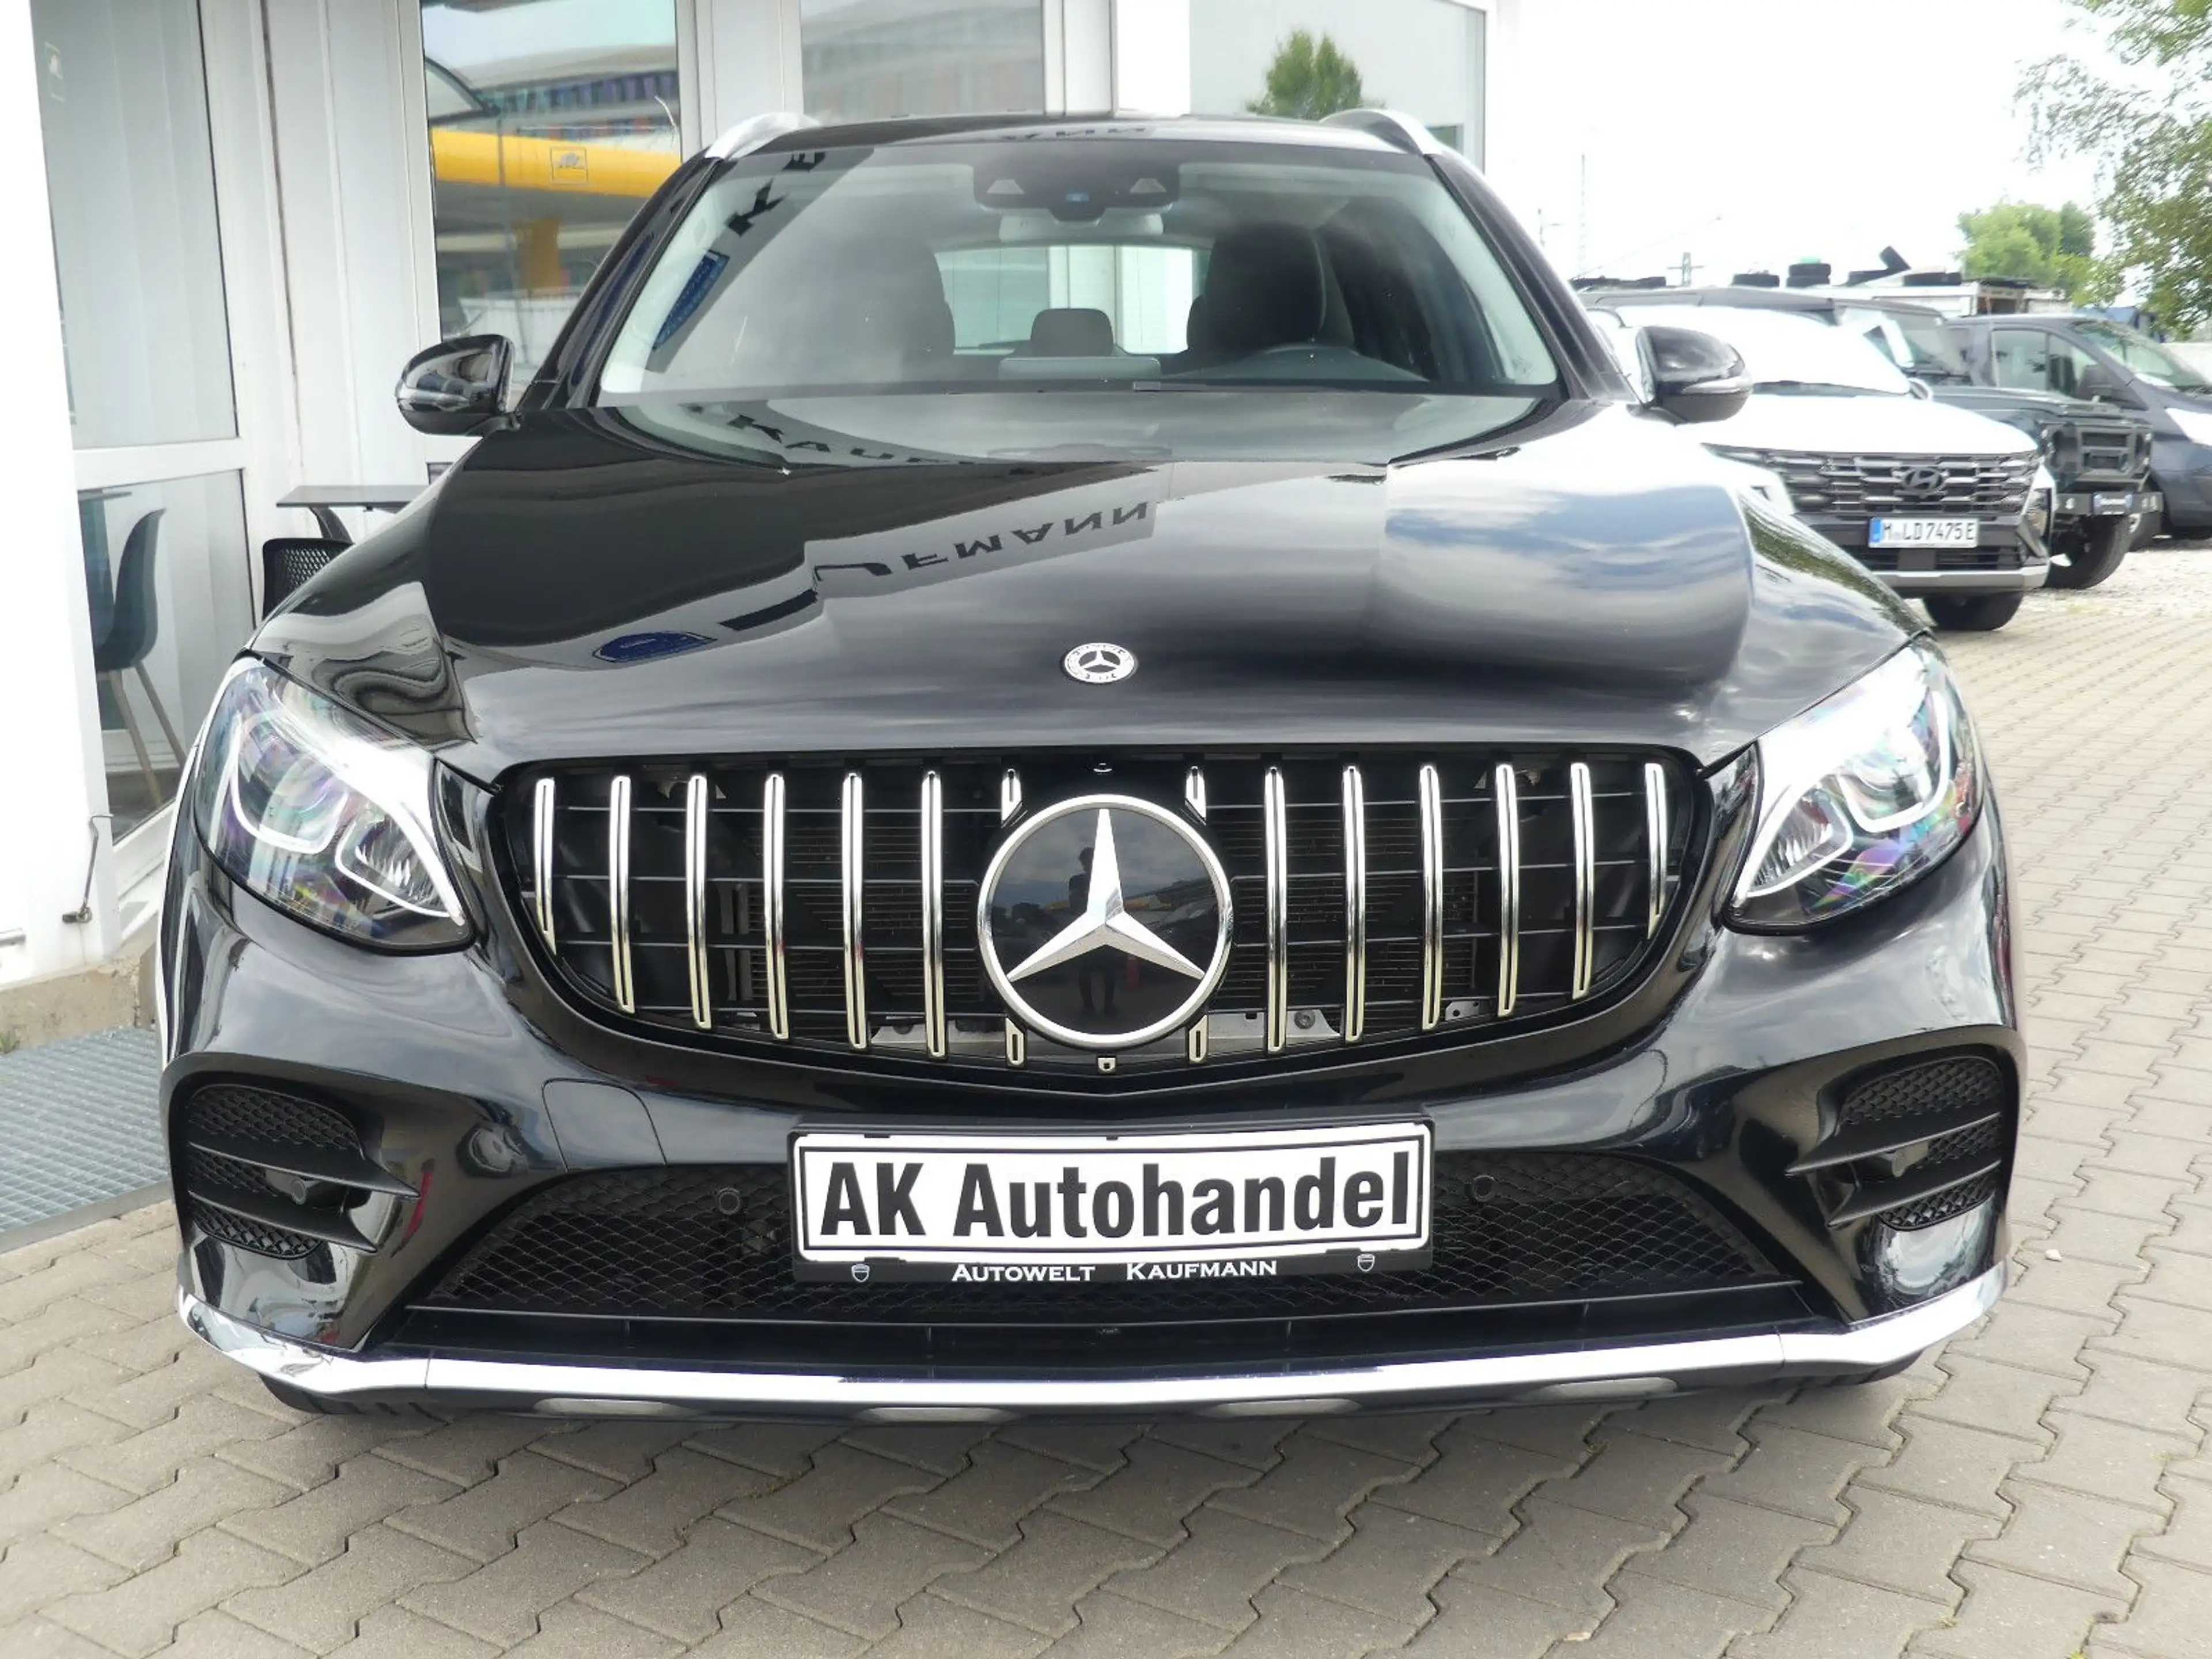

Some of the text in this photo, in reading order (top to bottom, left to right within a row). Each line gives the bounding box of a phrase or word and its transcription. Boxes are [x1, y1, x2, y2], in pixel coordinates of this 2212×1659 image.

[820, 1152, 1409, 1238] AK Autohandel
[952, 1260, 1277, 1282] AUTOWELT KAUFMANN
